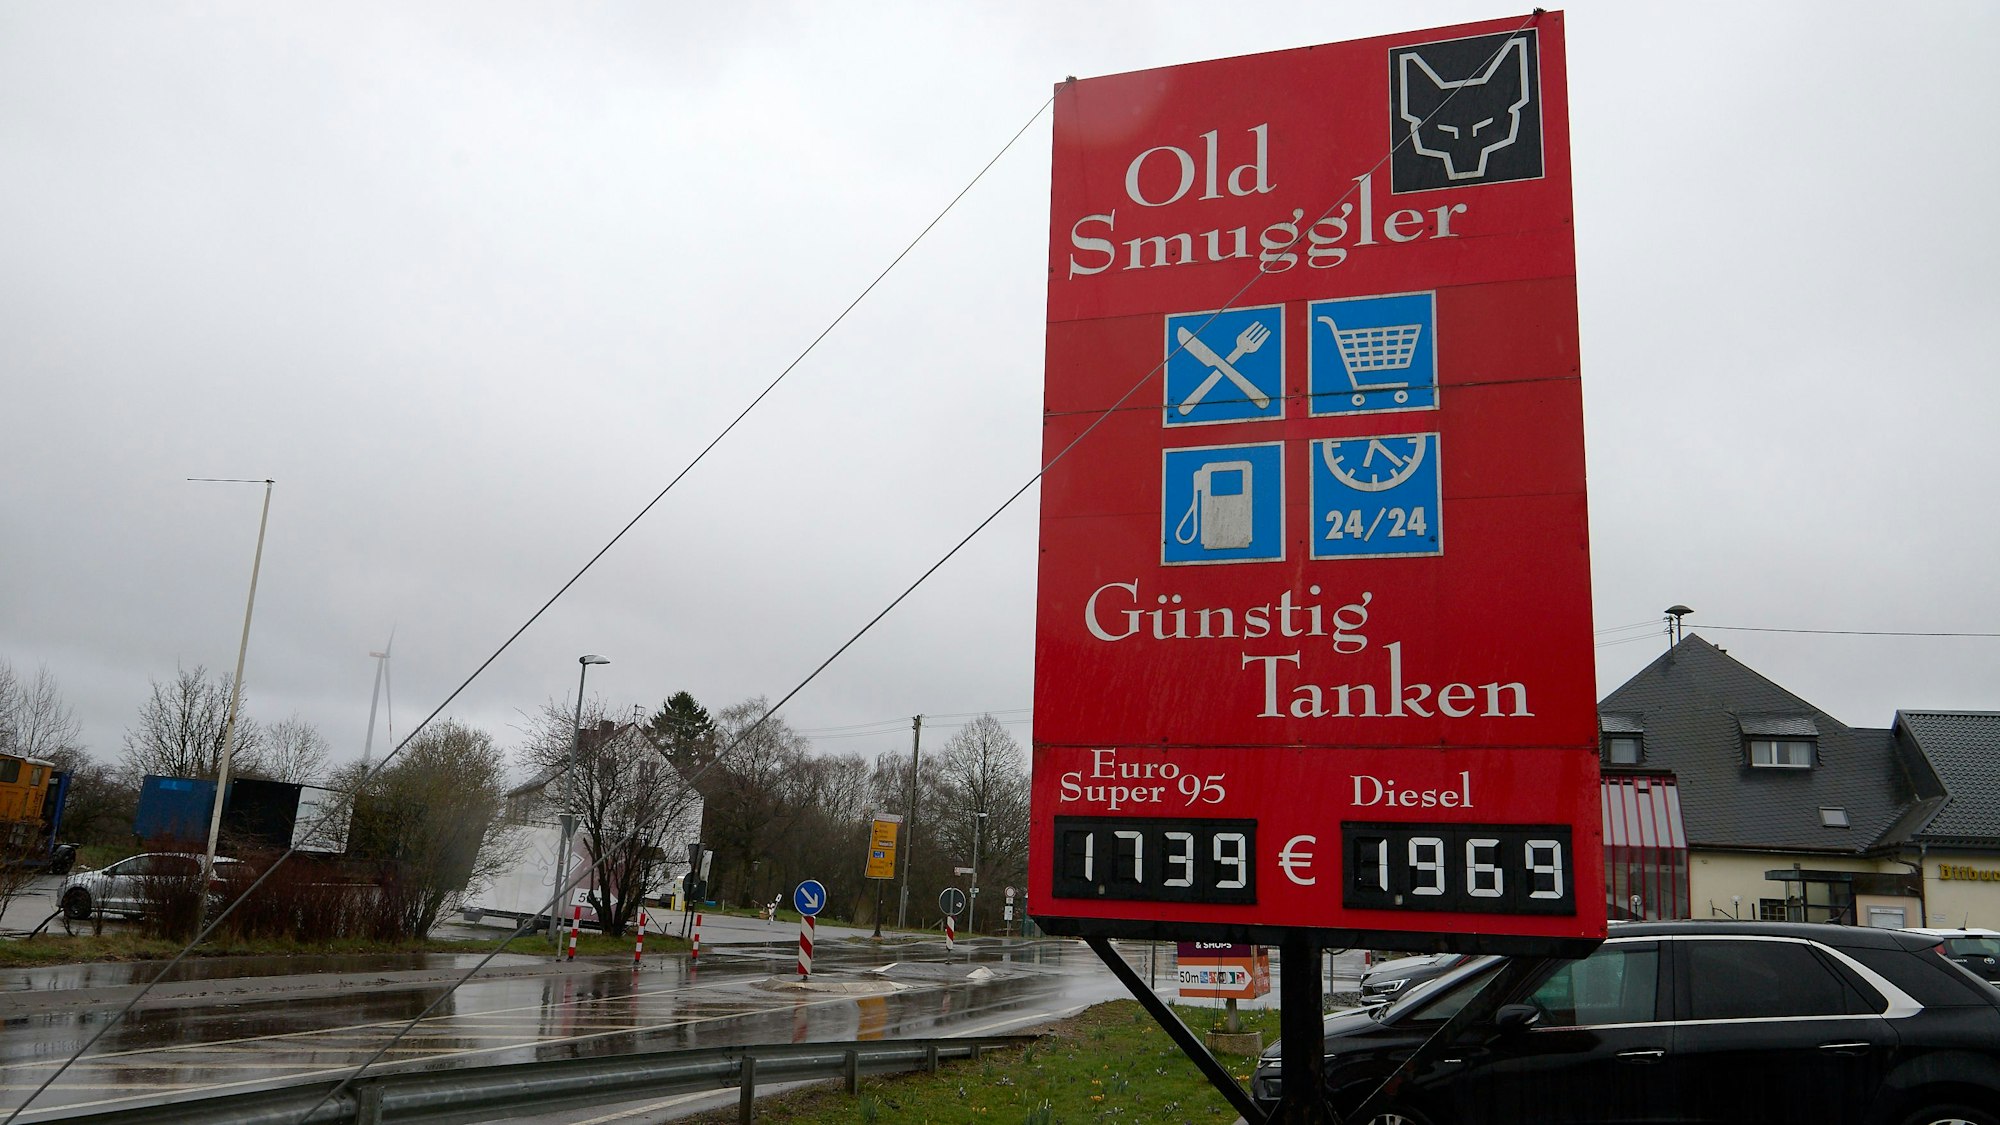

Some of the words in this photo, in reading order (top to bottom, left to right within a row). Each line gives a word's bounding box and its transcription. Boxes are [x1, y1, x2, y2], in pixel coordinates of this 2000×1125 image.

[1125, 123, 1277, 207] Old
[1069, 172, 1468, 281] Smuggler
[1325, 507, 1427, 542] 24/24
[1085, 578, 1373, 654] Günstig
[1242, 641, 1535, 718] Tanken
[1090, 748, 1180, 780] Euro
[1060, 770, 1166, 811] Super
[1178, 773, 1226, 807] 95
[1351, 771, 1474, 808] Diesel
[1278, 834, 1316, 886] €
[1180, 971, 1200, 984] 50m
